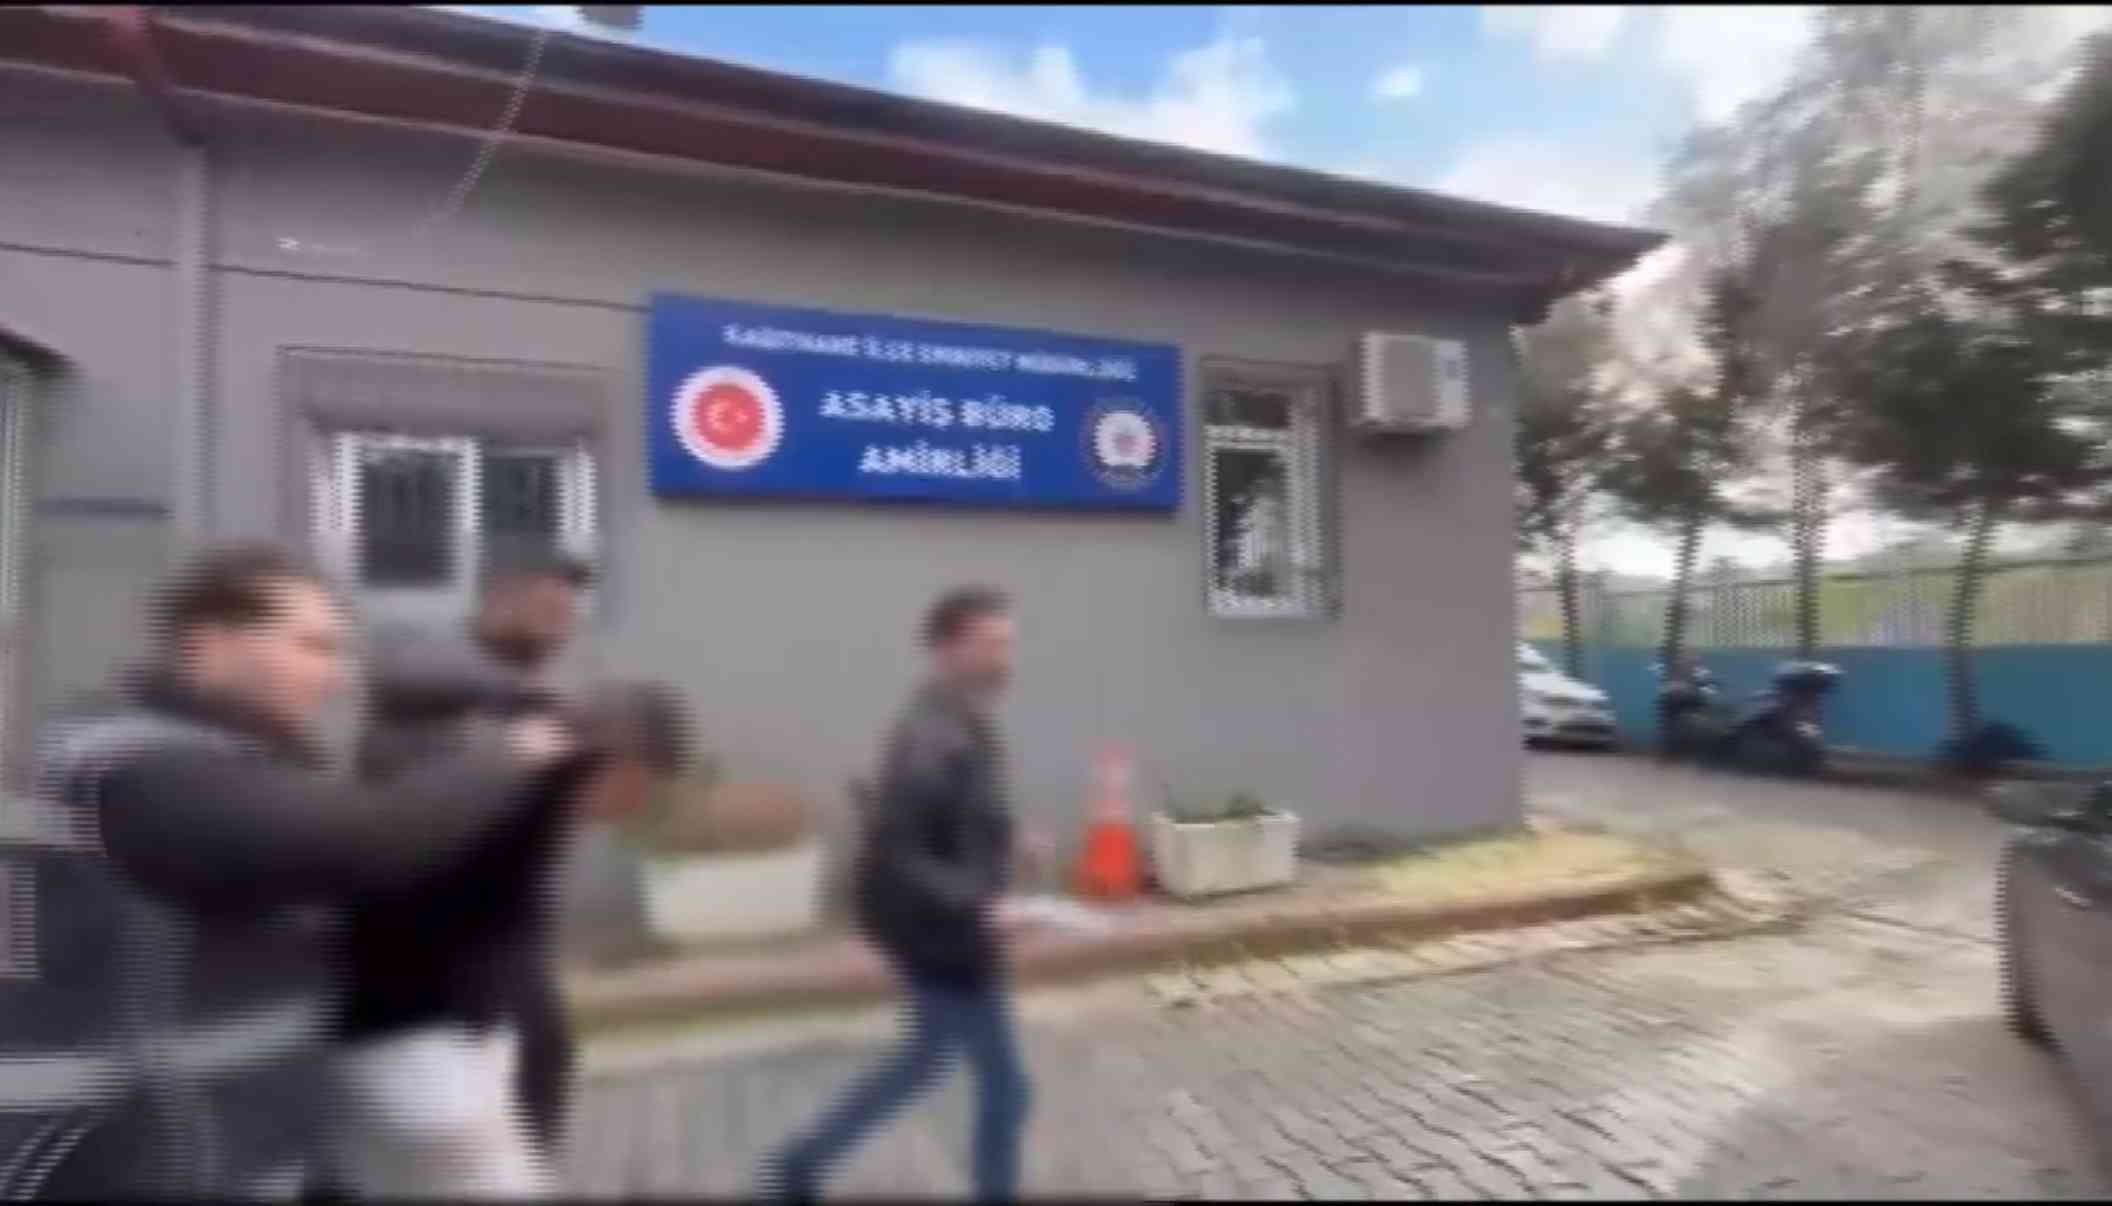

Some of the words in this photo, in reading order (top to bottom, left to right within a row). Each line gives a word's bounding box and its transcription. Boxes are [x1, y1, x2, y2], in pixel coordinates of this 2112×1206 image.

[819, 390, 953, 431] ASAYİŞ
[960, 394, 1055, 432] BÜRO
[858, 440, 1021, 479] AMİRLİĞİ
